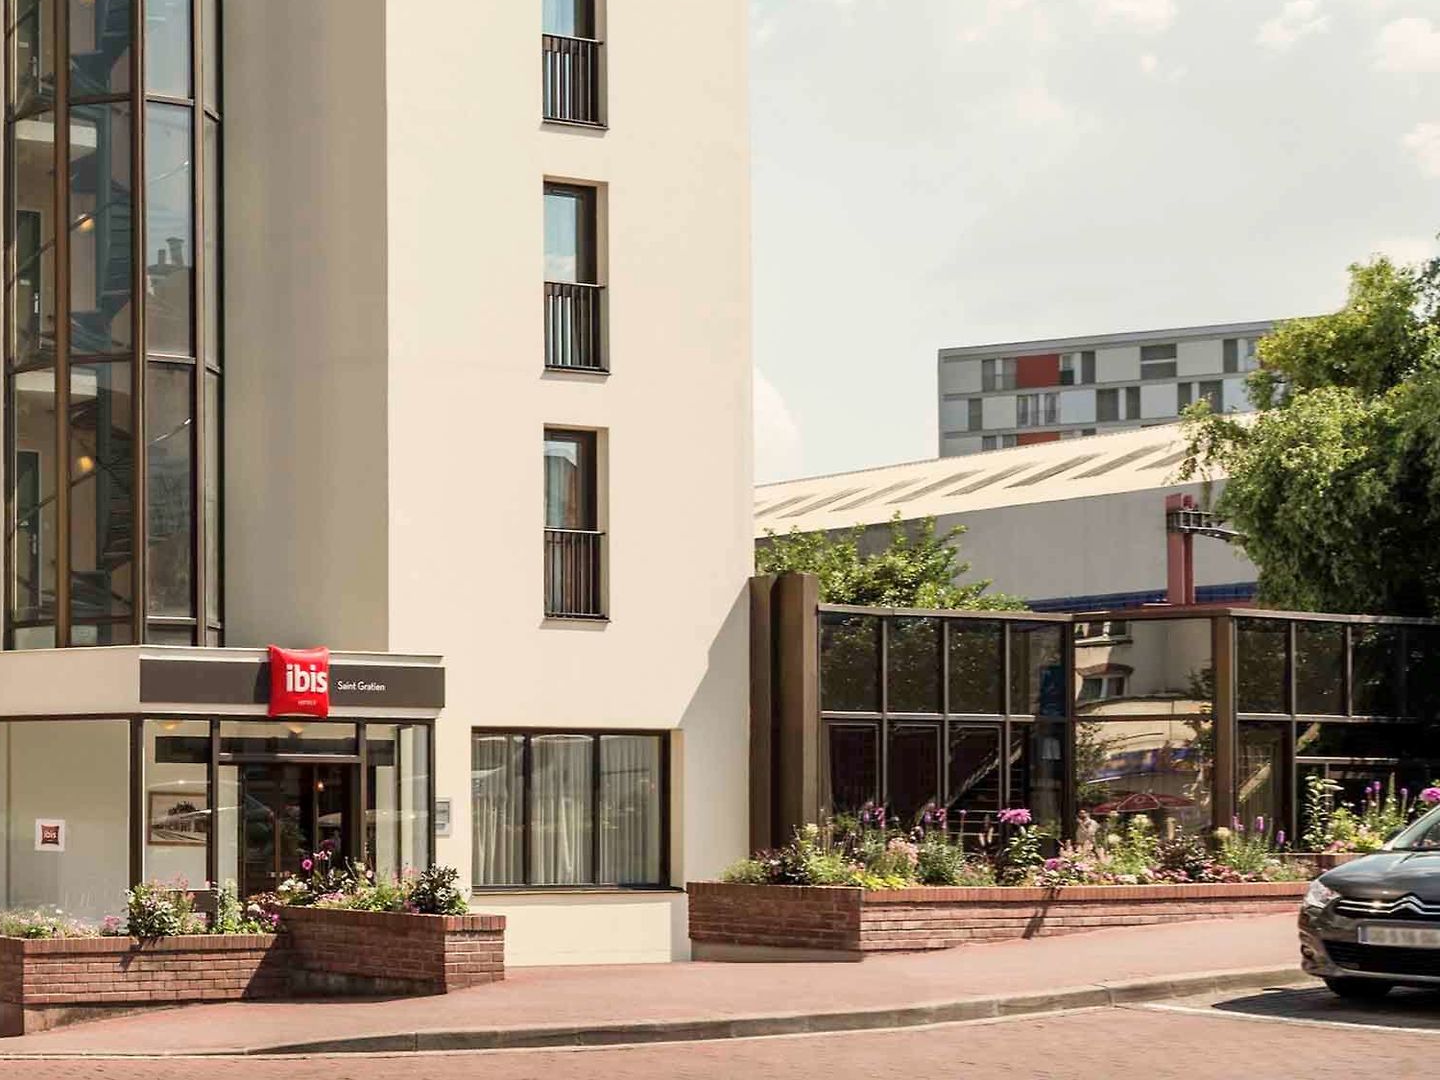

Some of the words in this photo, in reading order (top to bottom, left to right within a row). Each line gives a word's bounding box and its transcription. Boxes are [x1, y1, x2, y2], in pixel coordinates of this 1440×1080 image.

[286, 664, 328, 693] ibis
[337, 681, 357, 691] Saint
[357, 681, 386, 691] Gratien
